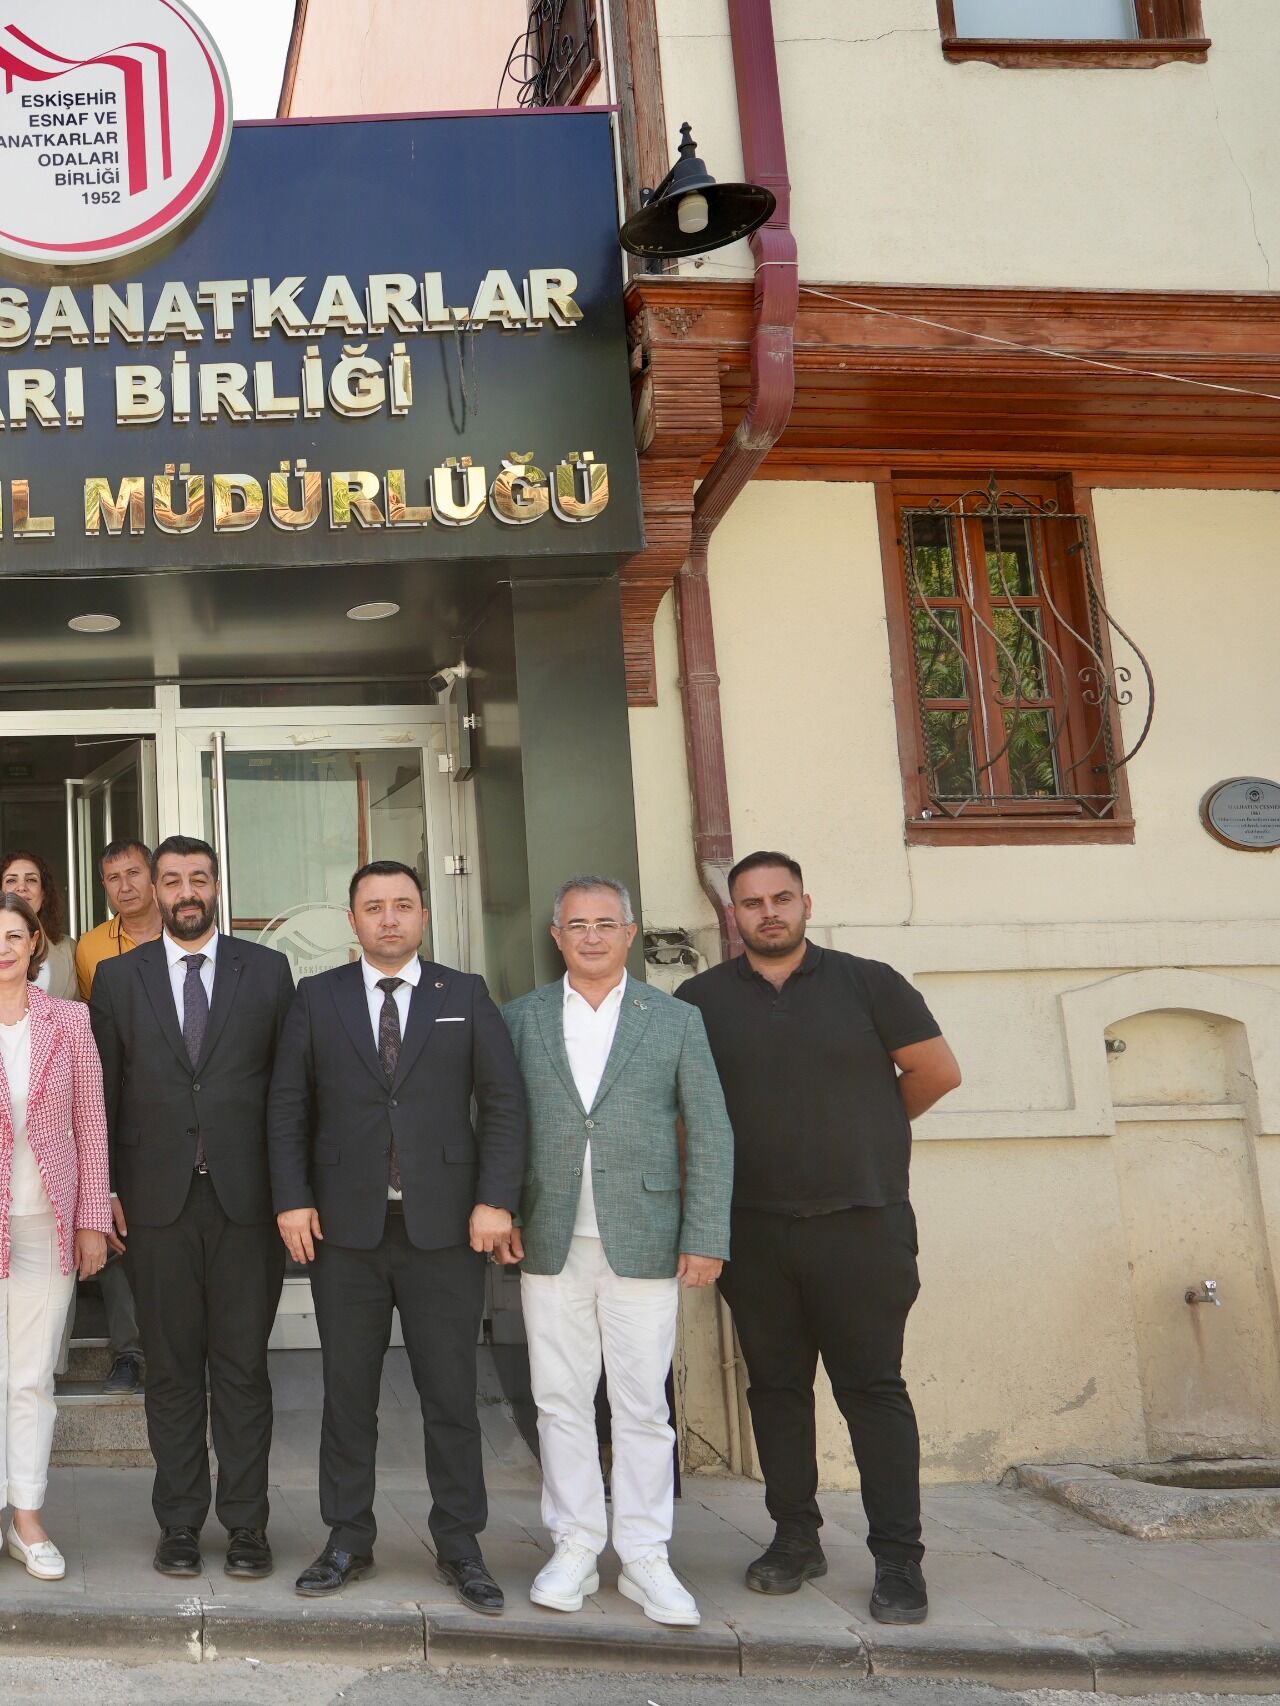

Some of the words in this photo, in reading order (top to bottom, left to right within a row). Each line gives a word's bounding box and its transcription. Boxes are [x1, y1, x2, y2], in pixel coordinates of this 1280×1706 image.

[21, 89, 116, 109] ESKİŞEHİR
[29, 113, 89, 128] ESNAF
[94, 111, 118, 125] VE
[37, 151, 119, 167] ODALARI
[55, 167, 120, 186] BİRLİĞİ
[81, 191, 121, 205] 1952
[115, 343, 412, 424] BİRLİĞİ
[84, 451, 609, 535] MÜDÜRLÜĞÜ
